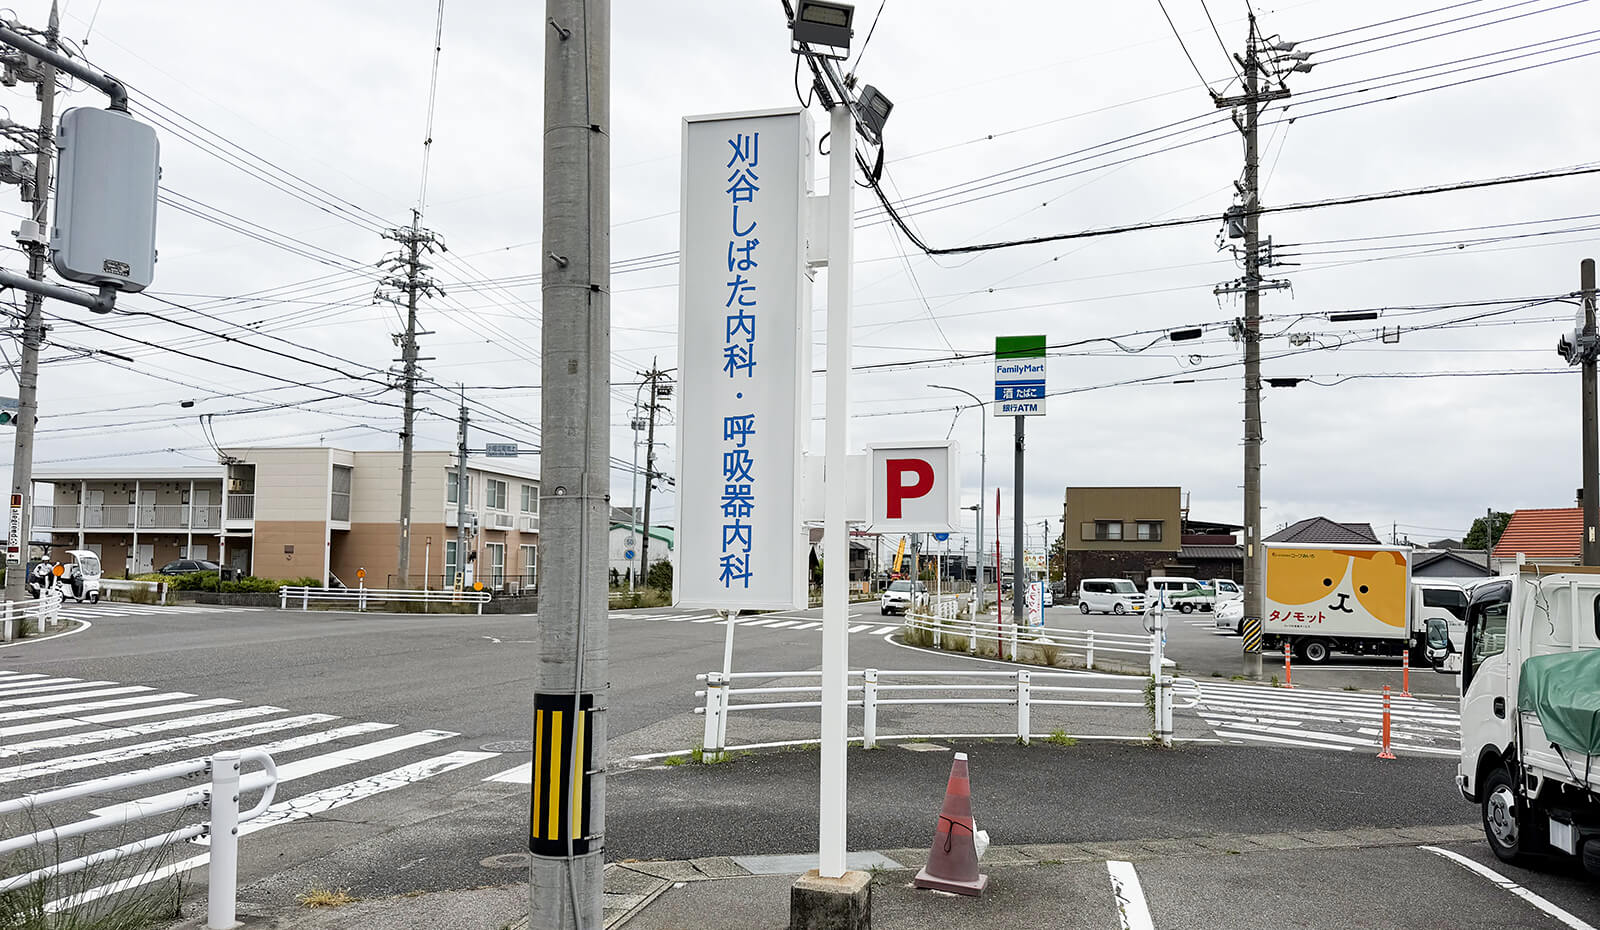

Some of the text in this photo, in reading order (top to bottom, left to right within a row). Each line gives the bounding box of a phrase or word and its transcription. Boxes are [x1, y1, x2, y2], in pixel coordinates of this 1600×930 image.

[718, 132, 760, 588] 刈谷しばた内科・呼吸器内科
[996, 364, 1044, 374] FamilyMart
[1003, 388, 1037, 399] 酒 たばこ
[1002, 403, 1038, 412] 銀行ATM
[886, 458, 935, 519] P
[1269, 610, 1326, 624] タノモット
